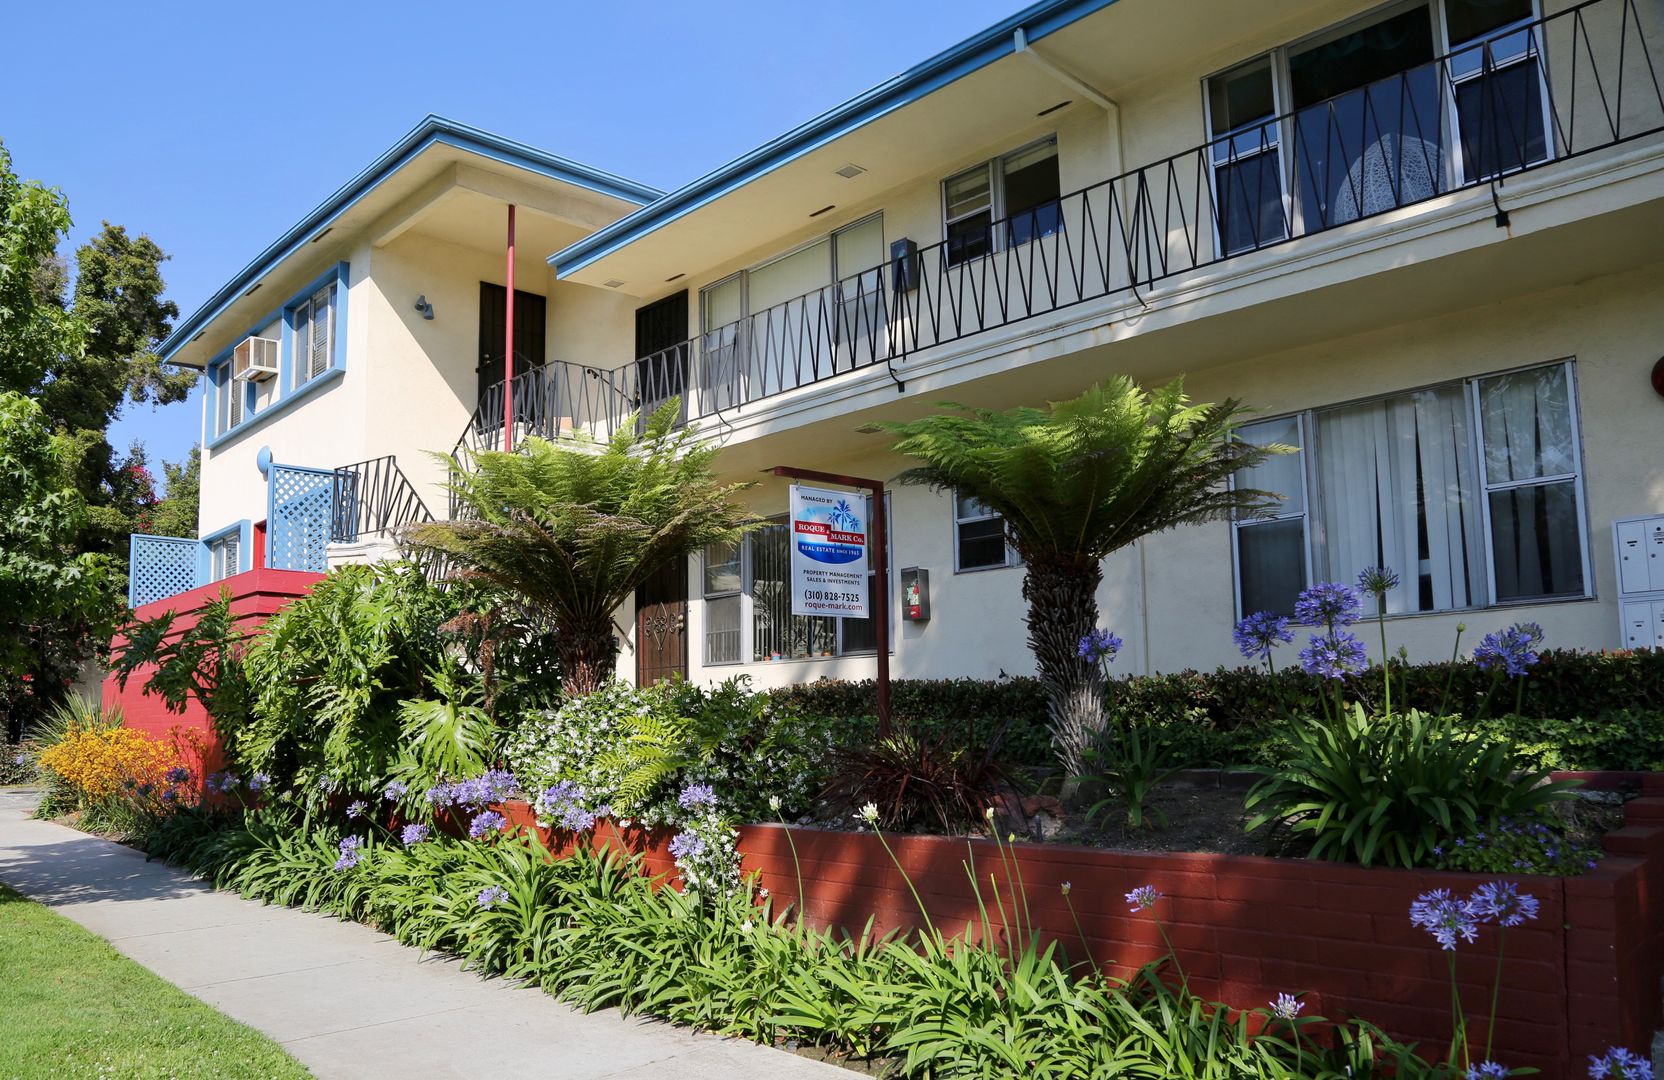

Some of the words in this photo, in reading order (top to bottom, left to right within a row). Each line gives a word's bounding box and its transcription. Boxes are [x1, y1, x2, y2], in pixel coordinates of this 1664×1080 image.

[801, 495, 825, 503] MANAGED
[798, 523, 825, 533] ROQUE
[830, 533, 852, 542] MARK
[852, 535, 864, 543] Co.
[803, 569, 828, 577] PROPERTY
[829, 571, 863, 579] MANAGEMENT
[827, 578, 860, 586] INVESTMENTS
[804, 589, 823, 601] (310)
[824, 591, 860, 602] 828-7525
[804, 601, 863, 611] roque-mark.com
